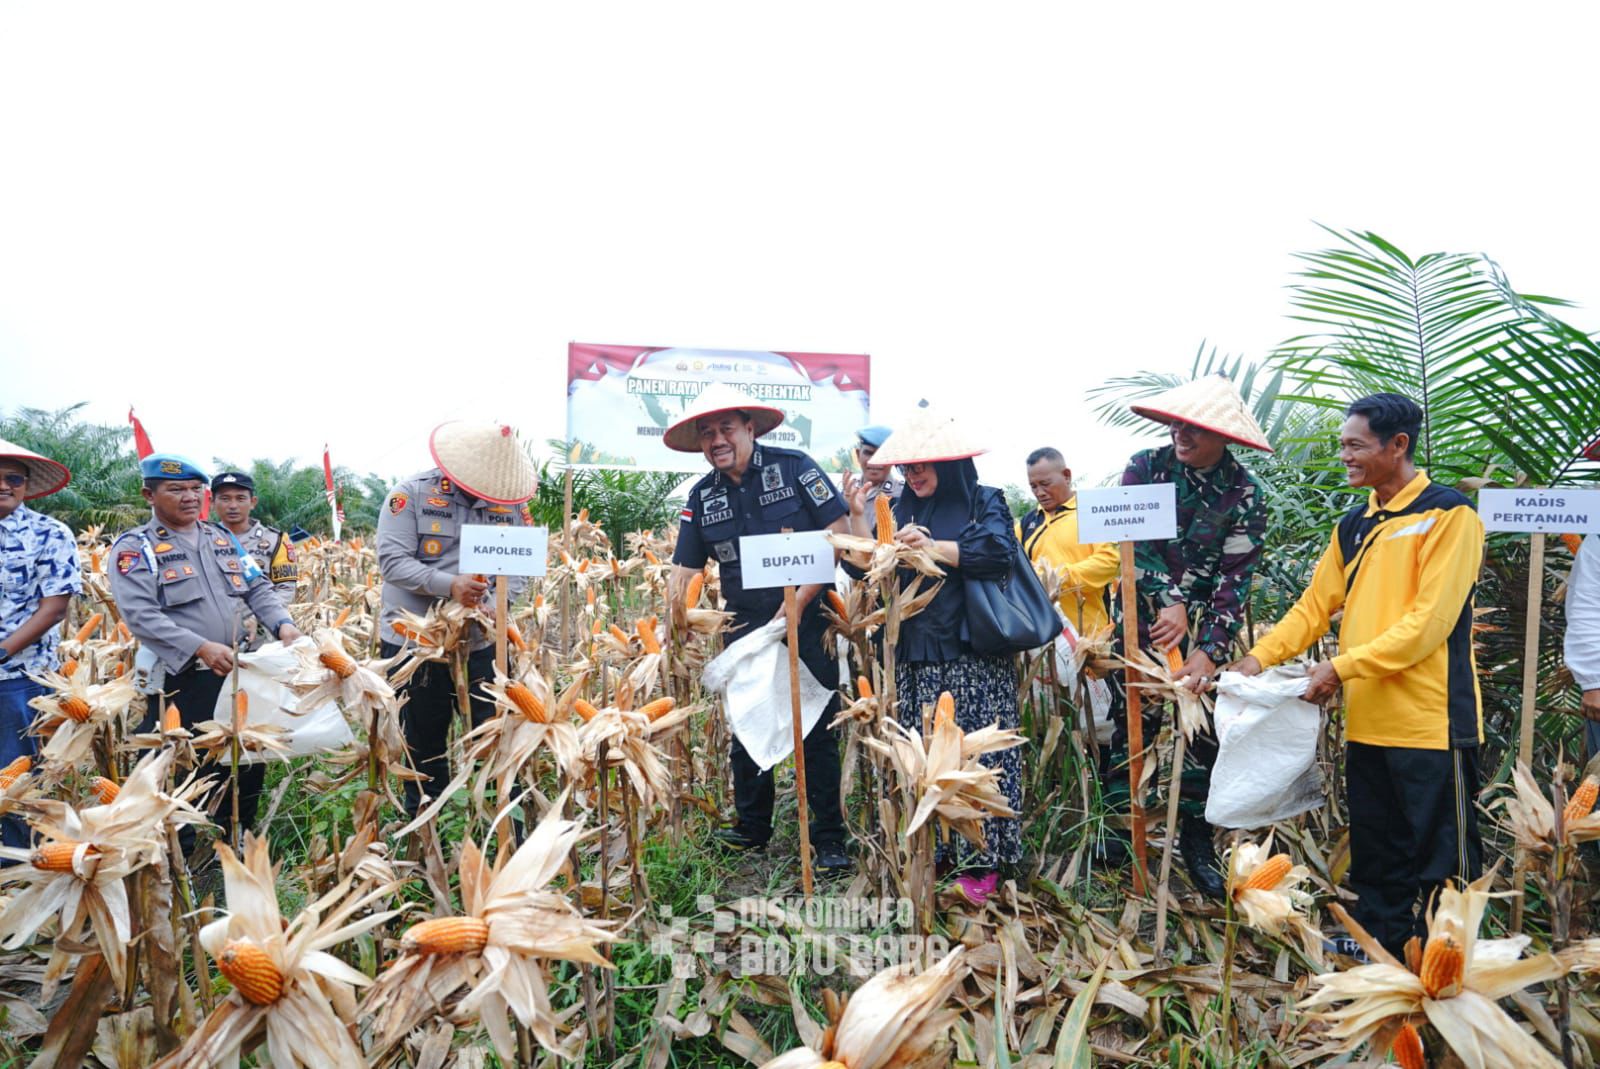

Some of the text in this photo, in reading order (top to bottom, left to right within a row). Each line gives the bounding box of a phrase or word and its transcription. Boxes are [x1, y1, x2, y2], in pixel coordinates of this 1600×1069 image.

[627, 378, 667, 395] PANEN
[668, 380, 699, 397] RAYA
[750, 383, 812, 401] SERENTAK
[778, 432, 796, 441] 2025
[760, 487, 794, 505] BUPATI
[1515, 497, 1566, 507] KADIS
[1091, 502, 1160, 514] DANDIM 02/08
[488, 514, 514, 524] POLRI
[1103, 516, 1145, 527] ASAHAN
[1493, 512, 1588, 524] PERTANIAN
[473, 545, 533, 556] KAPOLRES
[762, 554, 815, 568] BUPATI
